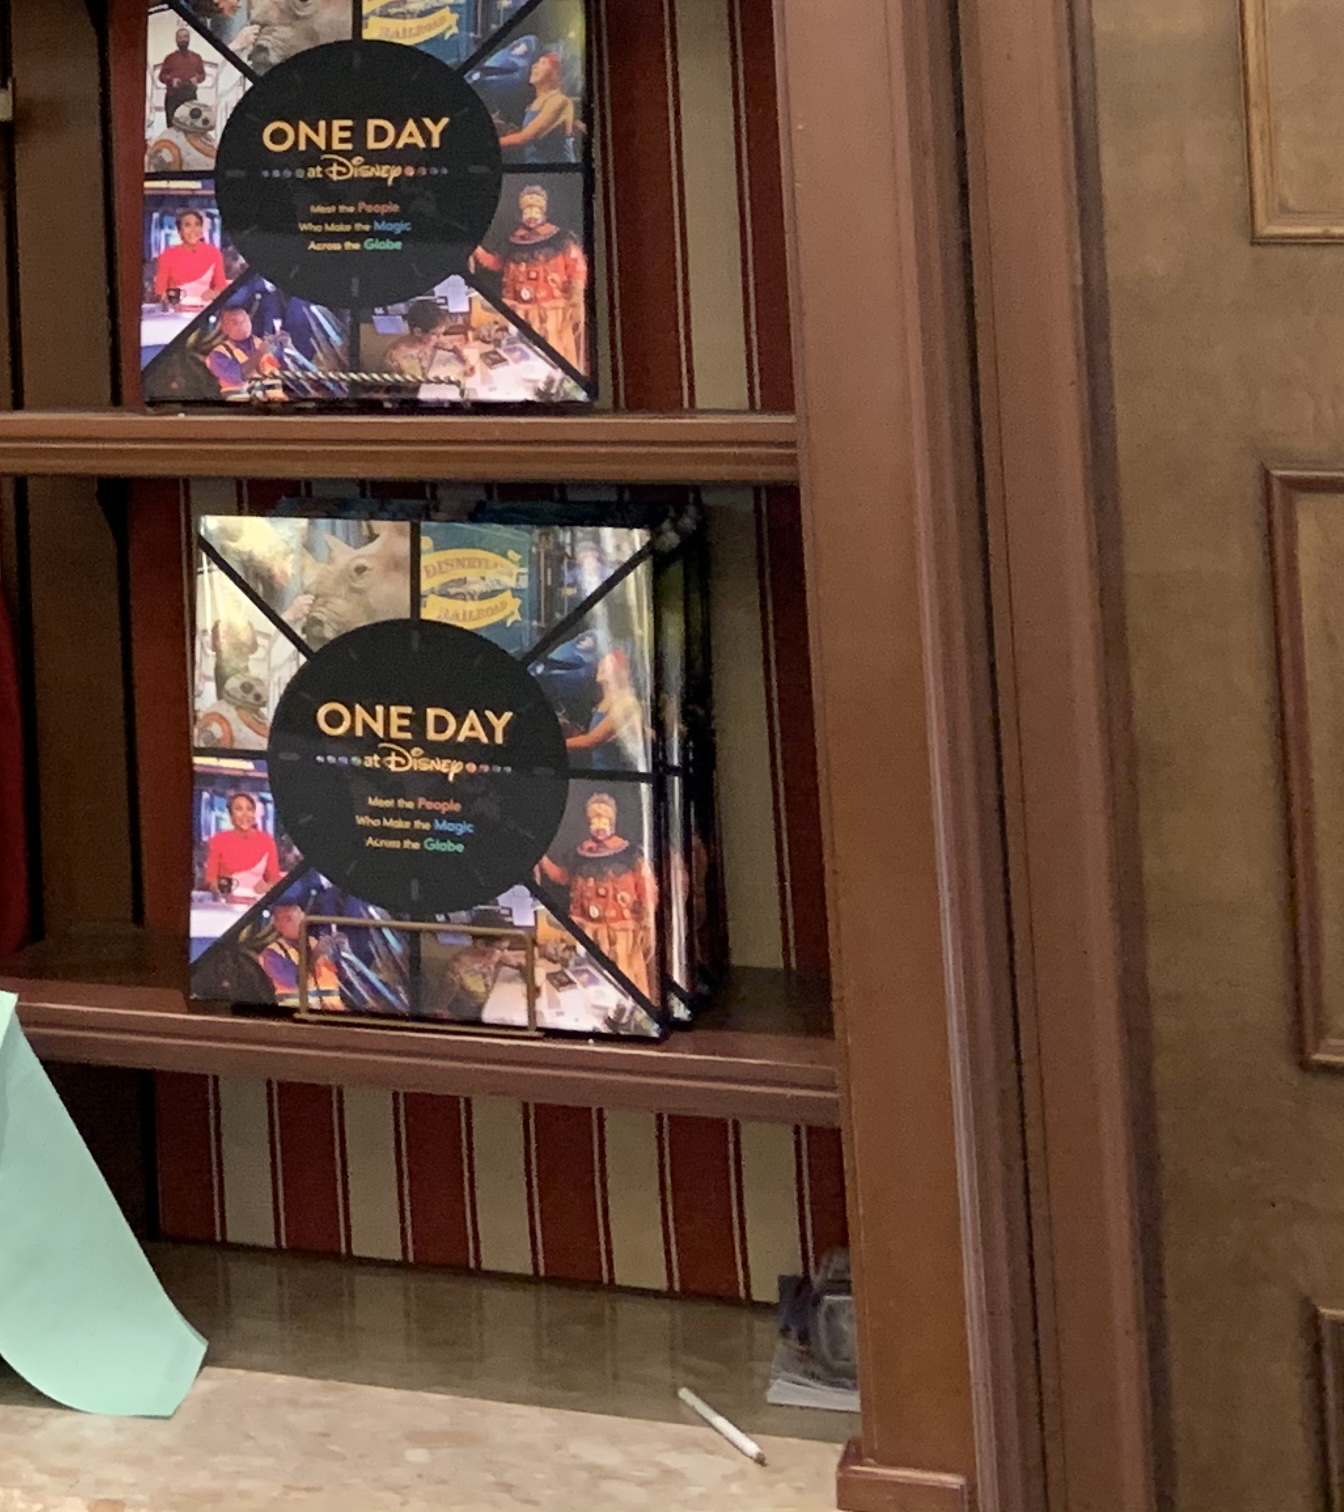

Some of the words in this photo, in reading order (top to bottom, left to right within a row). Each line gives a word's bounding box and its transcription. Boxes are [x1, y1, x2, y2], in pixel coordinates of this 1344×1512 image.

[262, 119, 354, 152] ONE
[366, 117, 450, 150] DAY
[307, 166, 323, 178] at
[320, 154, 402, 186] Disney
[316, 701, 412, 739] ONE
[426, 707, 513, 744] DAY
[363, 754, 381, 768] at
[377, 742, 463, 782] Disney
[417, 797, 462, 813] People
[433, 818, 474, 836] Magic
[423, 838, 464, 853] Globe
